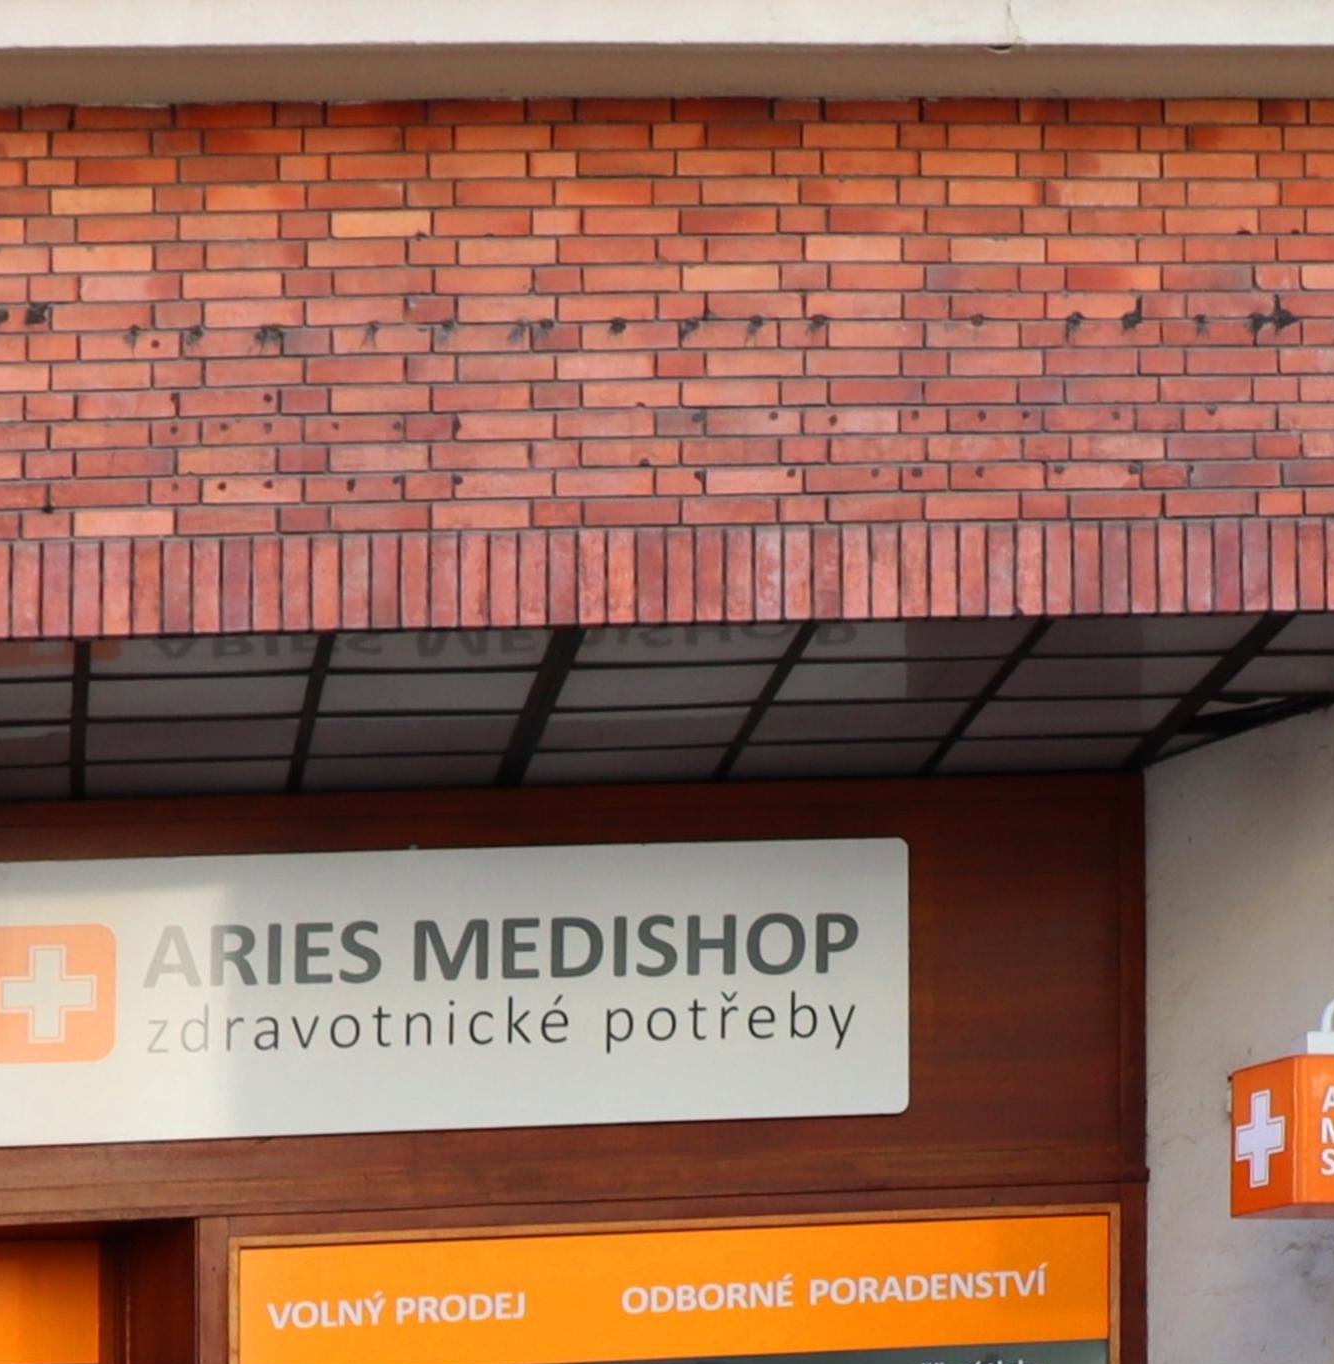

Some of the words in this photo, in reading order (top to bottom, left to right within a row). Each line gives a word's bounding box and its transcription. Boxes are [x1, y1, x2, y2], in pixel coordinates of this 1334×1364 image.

[144, 918, 382, 989] ARIES
[412, 911, 861, 982] MEDISHOP
[147, 995, 570, 1055] zdravotnické
[604, 991, 858, 1053] potřeby
[267, 1291, 384, 1330] VOLNÝ
[395, 1292, 527, 1325] PRODEJ
[621, 1273, 794, 1314] ODBORNÉ
[809, 1262, 1048, 1306] PORADENSTVÍ
